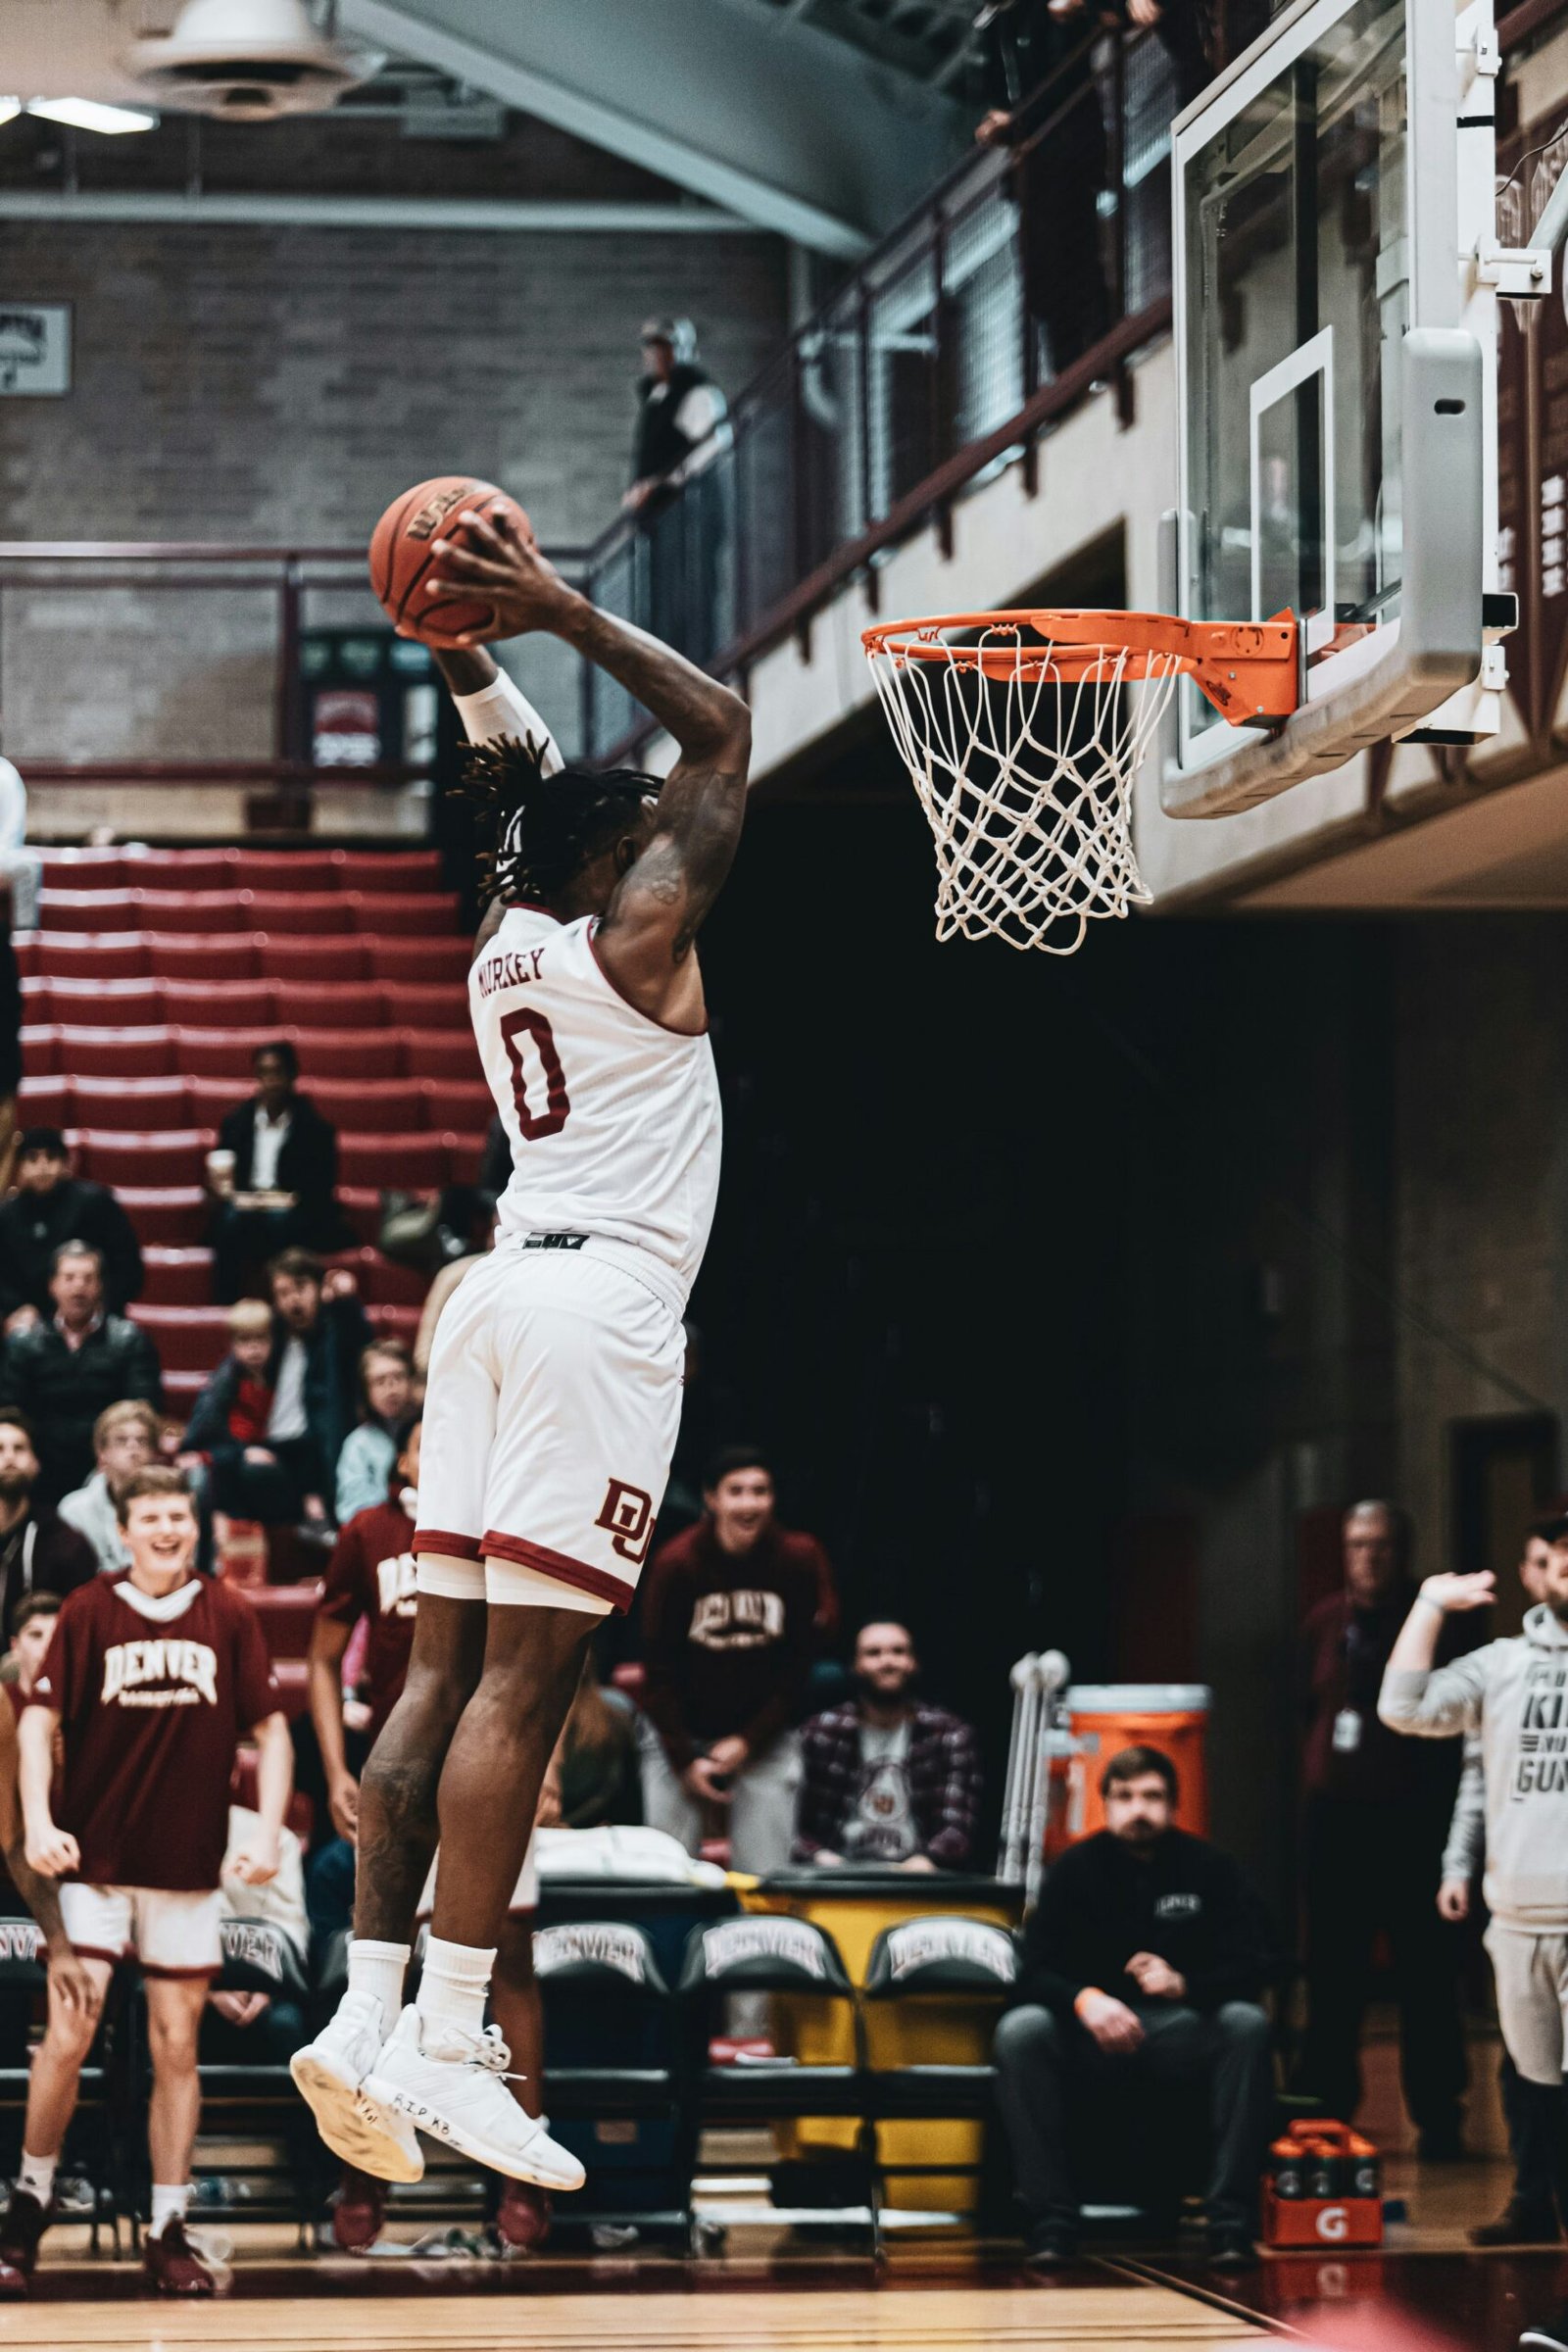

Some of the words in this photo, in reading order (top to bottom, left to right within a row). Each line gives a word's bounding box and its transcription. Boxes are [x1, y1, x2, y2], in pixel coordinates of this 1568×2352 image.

[500, 1006, 571, 1142] 0
[100, 1638, 218, 1706] DENVER
[1315, 2207, 1348, 2240] G
